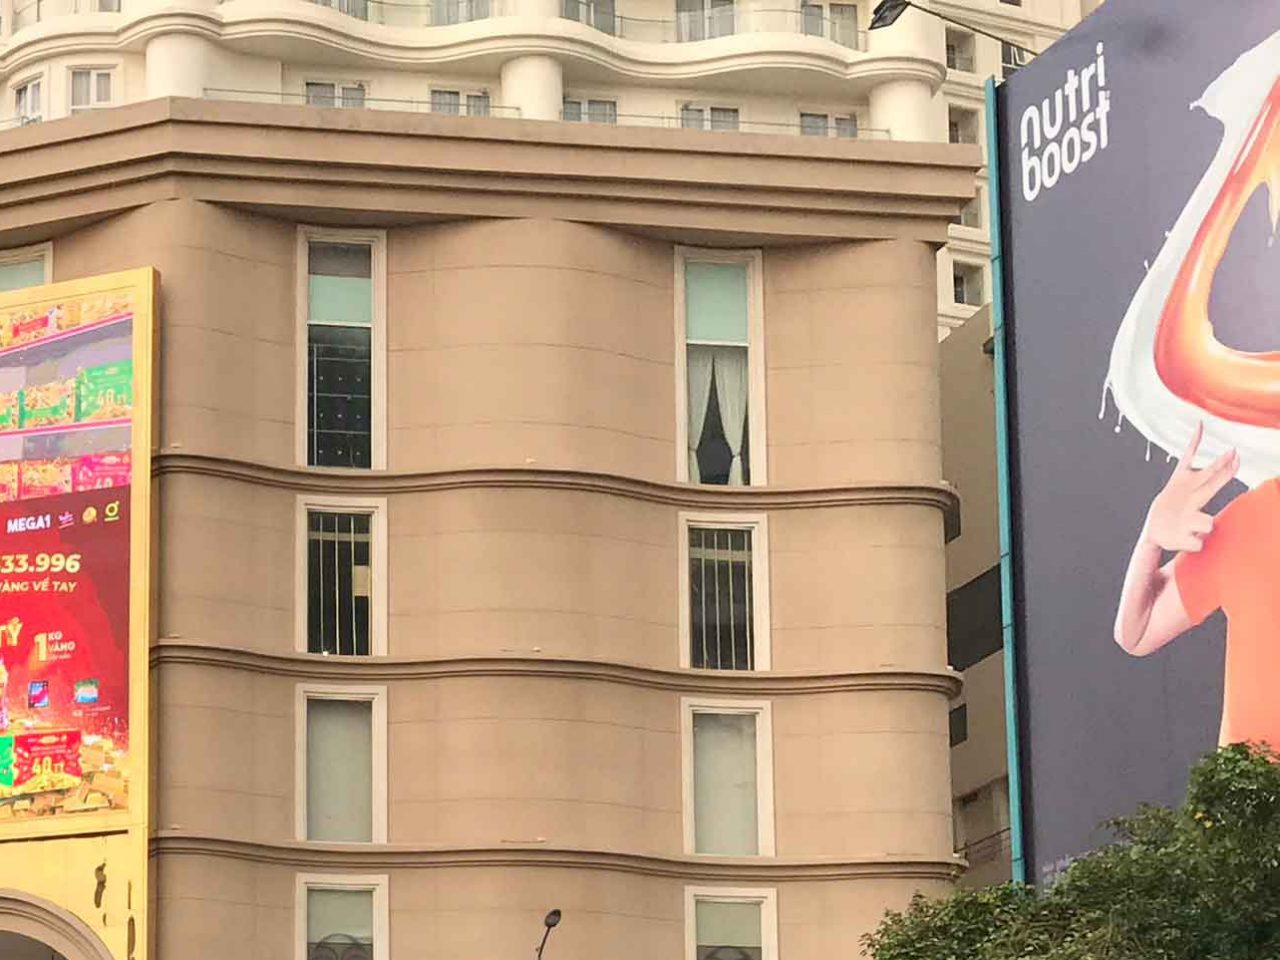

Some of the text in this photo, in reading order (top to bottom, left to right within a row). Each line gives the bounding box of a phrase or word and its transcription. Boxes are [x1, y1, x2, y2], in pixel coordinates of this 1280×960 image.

[1021, 42, 1106, 149] nutri
[1022, 90, 1110, 202] boost
[7, 513, 51, 534] MEGA1
[52, 580, 77, 593] TAY
